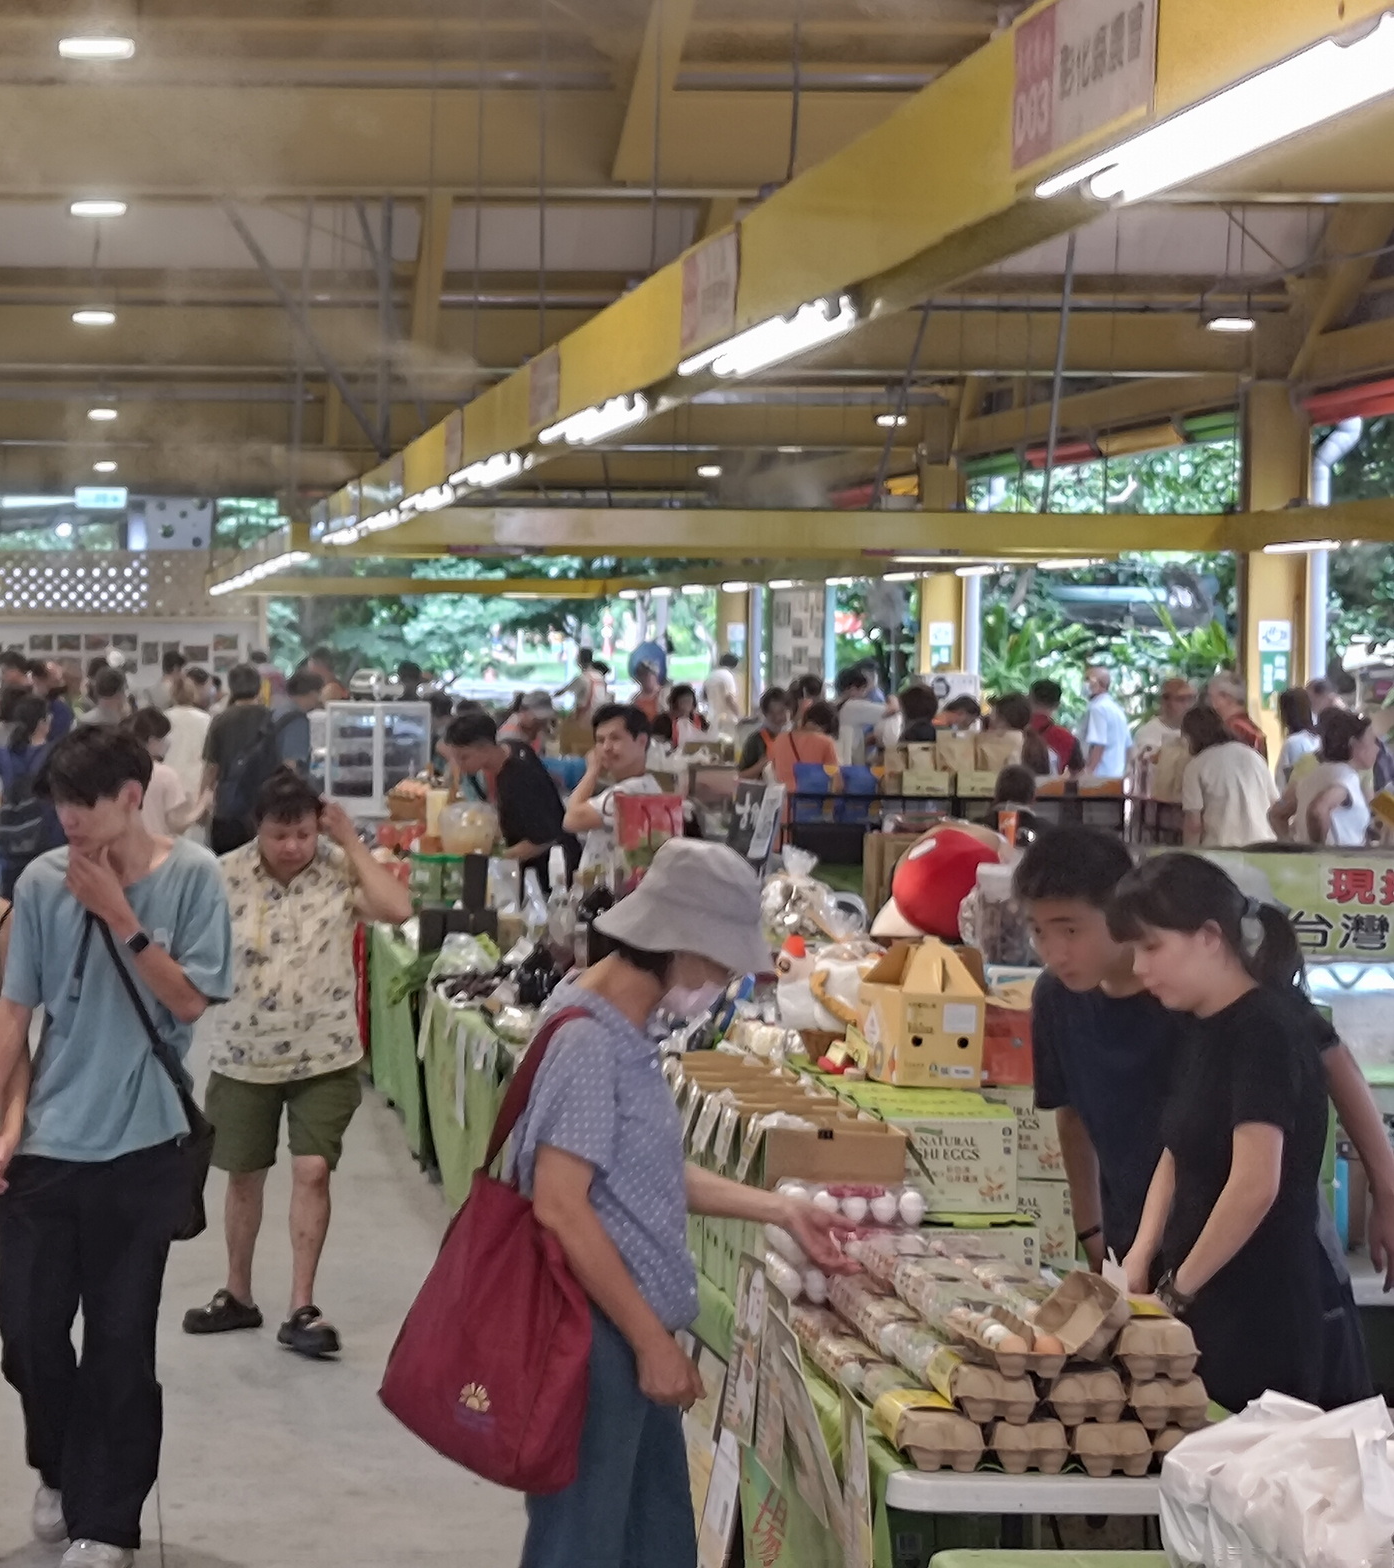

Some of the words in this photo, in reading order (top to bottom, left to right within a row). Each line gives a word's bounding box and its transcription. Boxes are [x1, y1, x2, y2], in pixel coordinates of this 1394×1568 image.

[1290, 910, 1390, 951] 台灣
[919, 1136, 976, 1147] NATURAL
[943, 1148, 981, 1161] EGGS
